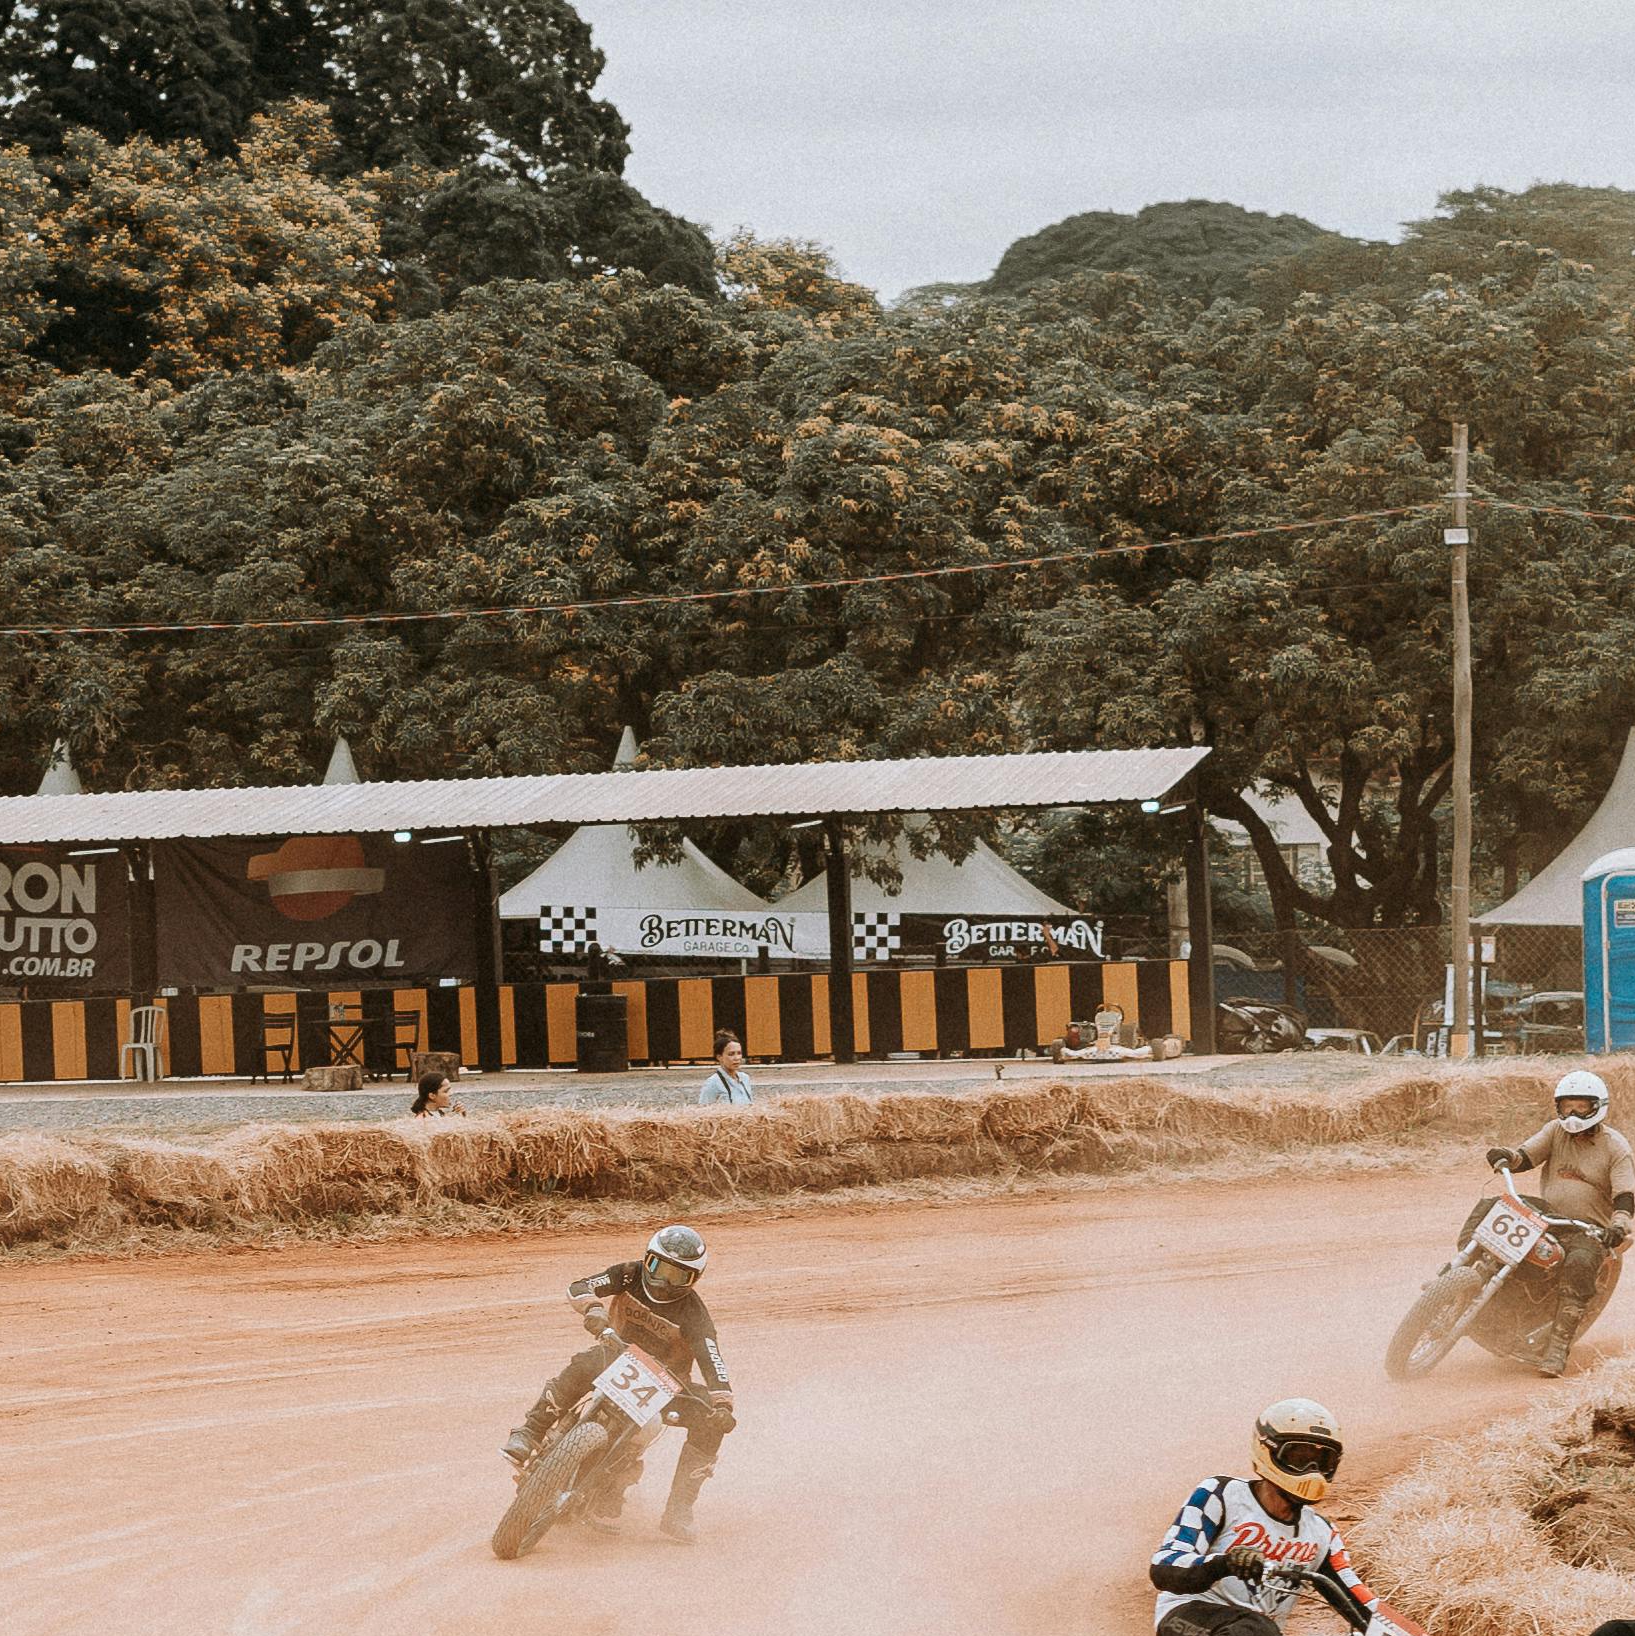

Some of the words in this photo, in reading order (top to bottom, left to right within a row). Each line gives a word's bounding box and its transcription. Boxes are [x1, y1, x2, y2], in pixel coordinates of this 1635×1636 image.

[639, 914, 797, 954] BETTERMAN
[683, 940, 730, 953] GARAGE
[942, 918, 1106, 958] BETTERMAN
[1, 956, 96, 978] .COM.BR
[230, 939, 405, 972] REPSOL
[1491, 1213, 1531, 1249] 68
[610, 1363, 659, 1409] 34
[1224, 1520, 1319, 1563] Prime
